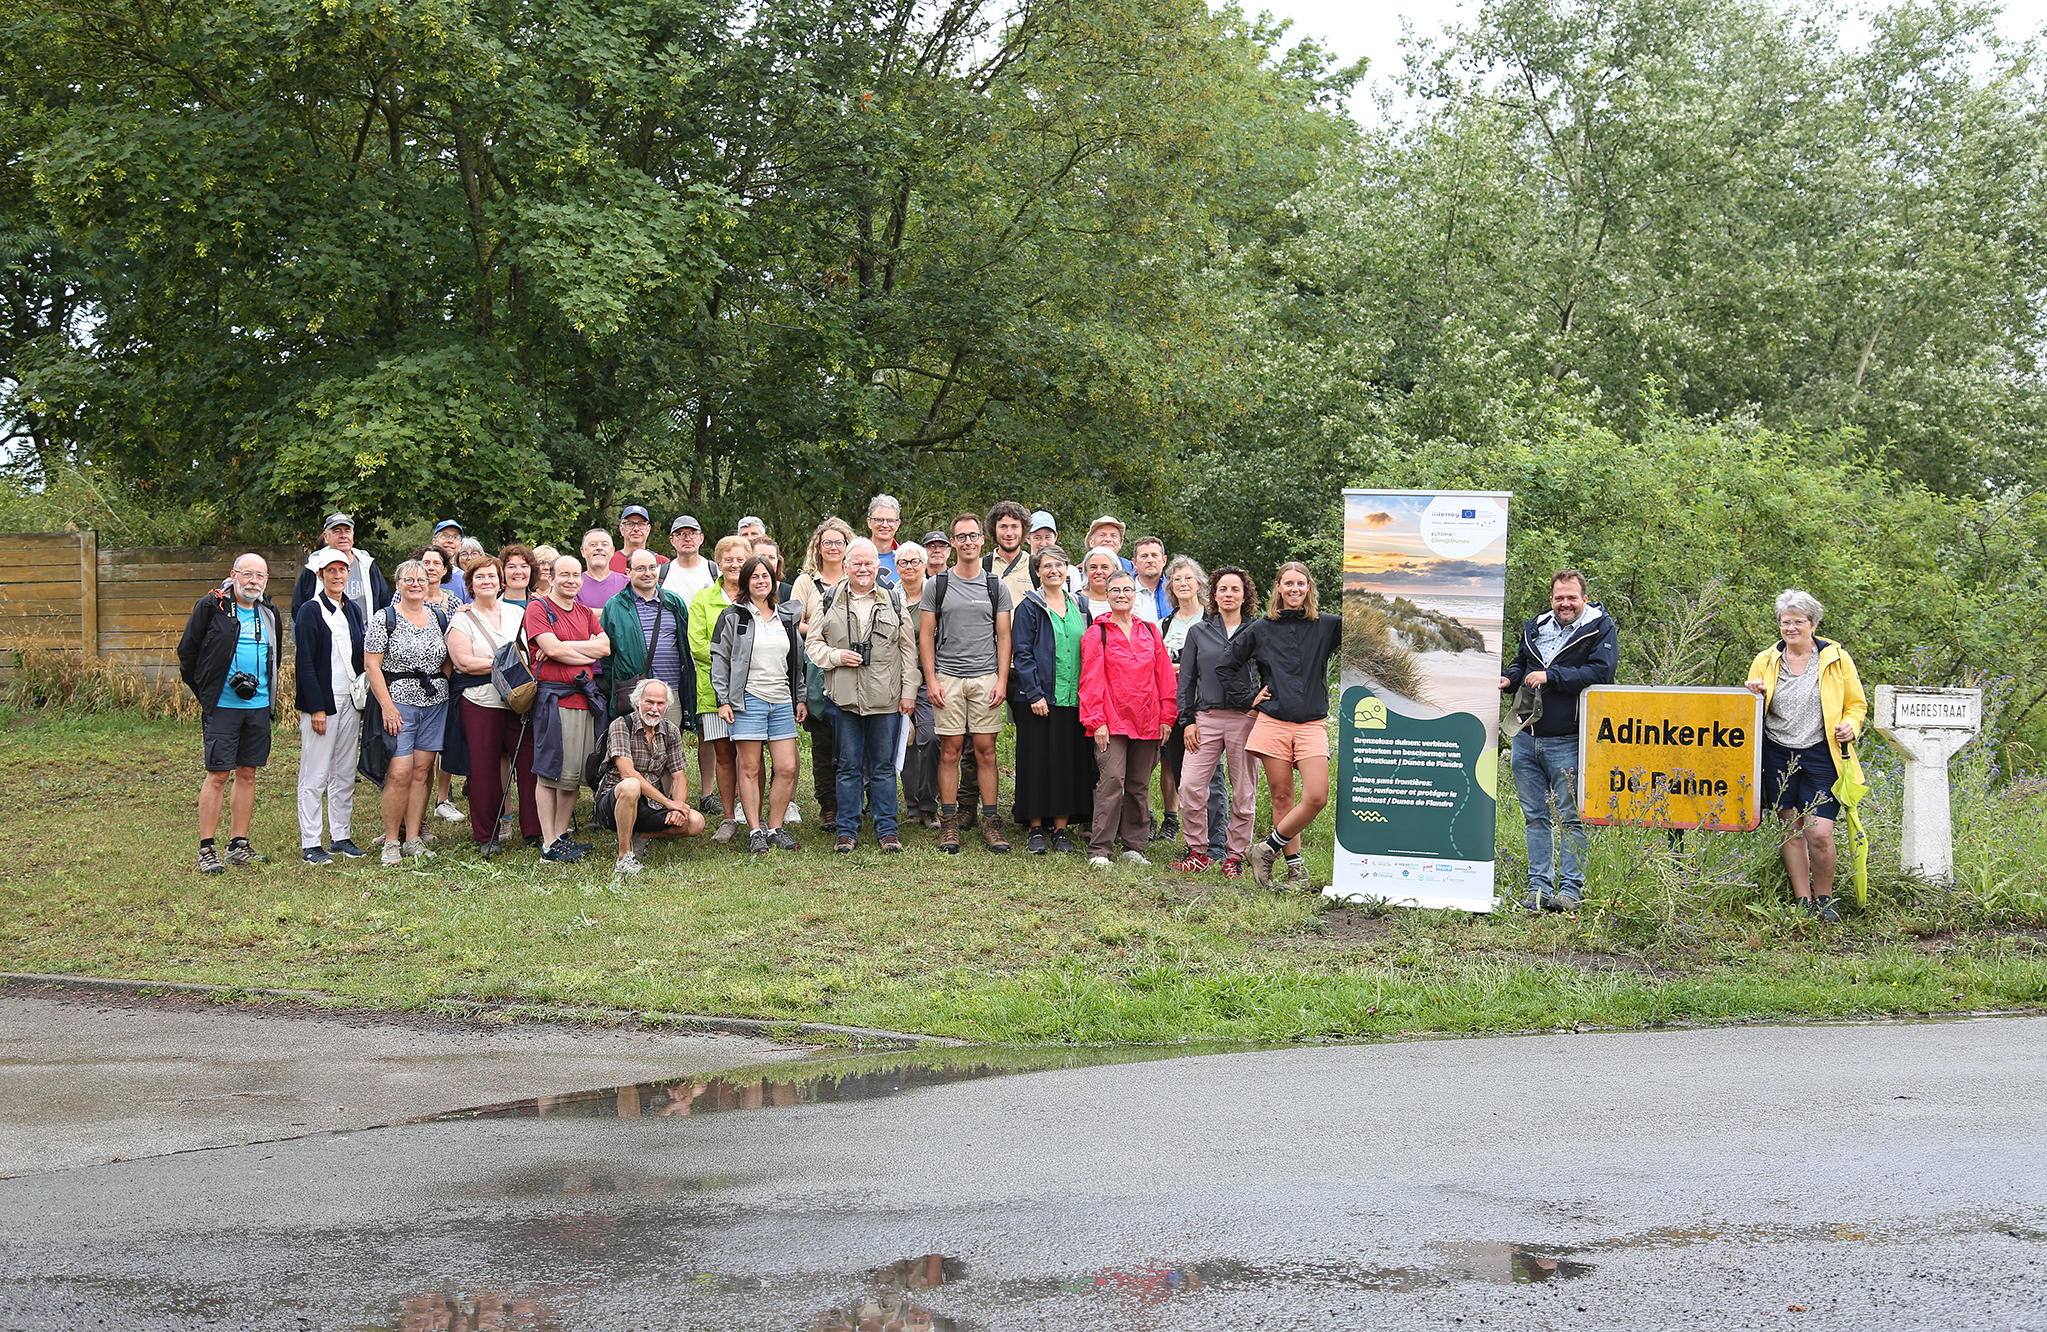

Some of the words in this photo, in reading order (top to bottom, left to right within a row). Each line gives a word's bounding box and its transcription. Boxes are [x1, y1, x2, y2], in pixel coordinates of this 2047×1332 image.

[1901, 703, 1967, 718] MAERESTRAAT
[1596, 717, 1745, 748] Adinkerke
[1353, 736, 1394, 745] Grenzeloze
[1395, 738, 1421, 746] duinen:
[1421, 740, 1460, 749] verbinden,
[1353, 747, 1392, 755] versterken
[1402, 749, 1447, 758] beschermen
[1363, 757, 1397, 765] Westkust
[1402, 759, 1425, 767] Dunes
[1436, 760, 1464, 769] Flandre
[1394, 778, 1433, 787] frontières:
[1610, 770, 1640, 792] De
[1352, 786, 1373, 794] relier,
[1416, 789, 1449, 798] protéger
[1449, 790, 1457, 798] la
[1352, 795, 1386, 804] Westkust
[1391, 798, 1414, 806] Dunes
[1425, 799, 1454, 808] Flandre
